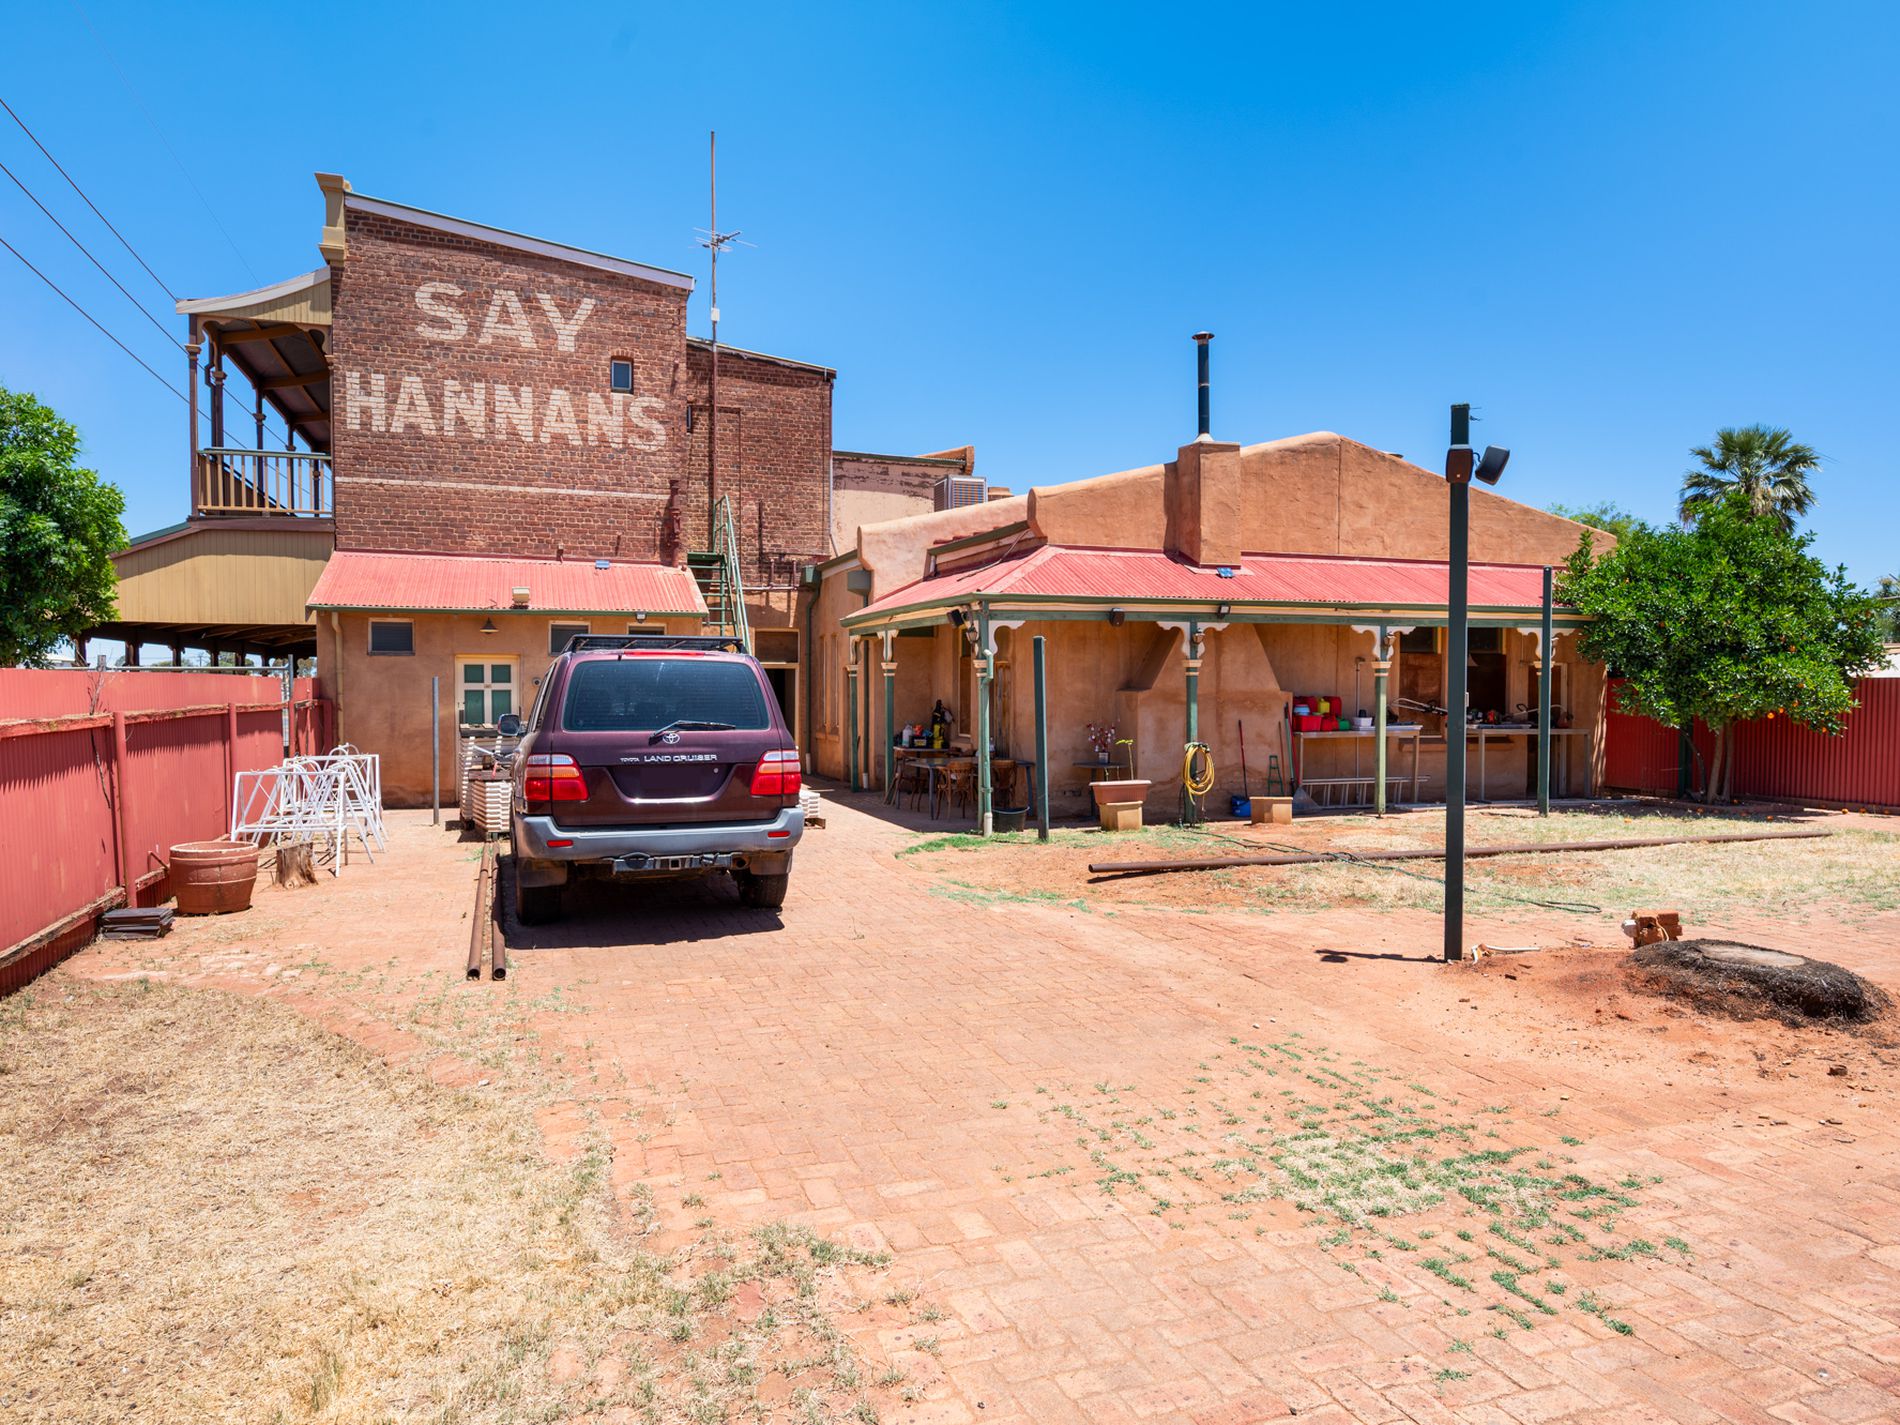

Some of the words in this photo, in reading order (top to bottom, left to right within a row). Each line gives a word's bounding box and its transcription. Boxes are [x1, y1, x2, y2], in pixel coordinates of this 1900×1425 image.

[414, 281, 597, 352] SAY
[345, 371, 668, 452] HANNANS
[672, 754, 718, 762] CRUISER
